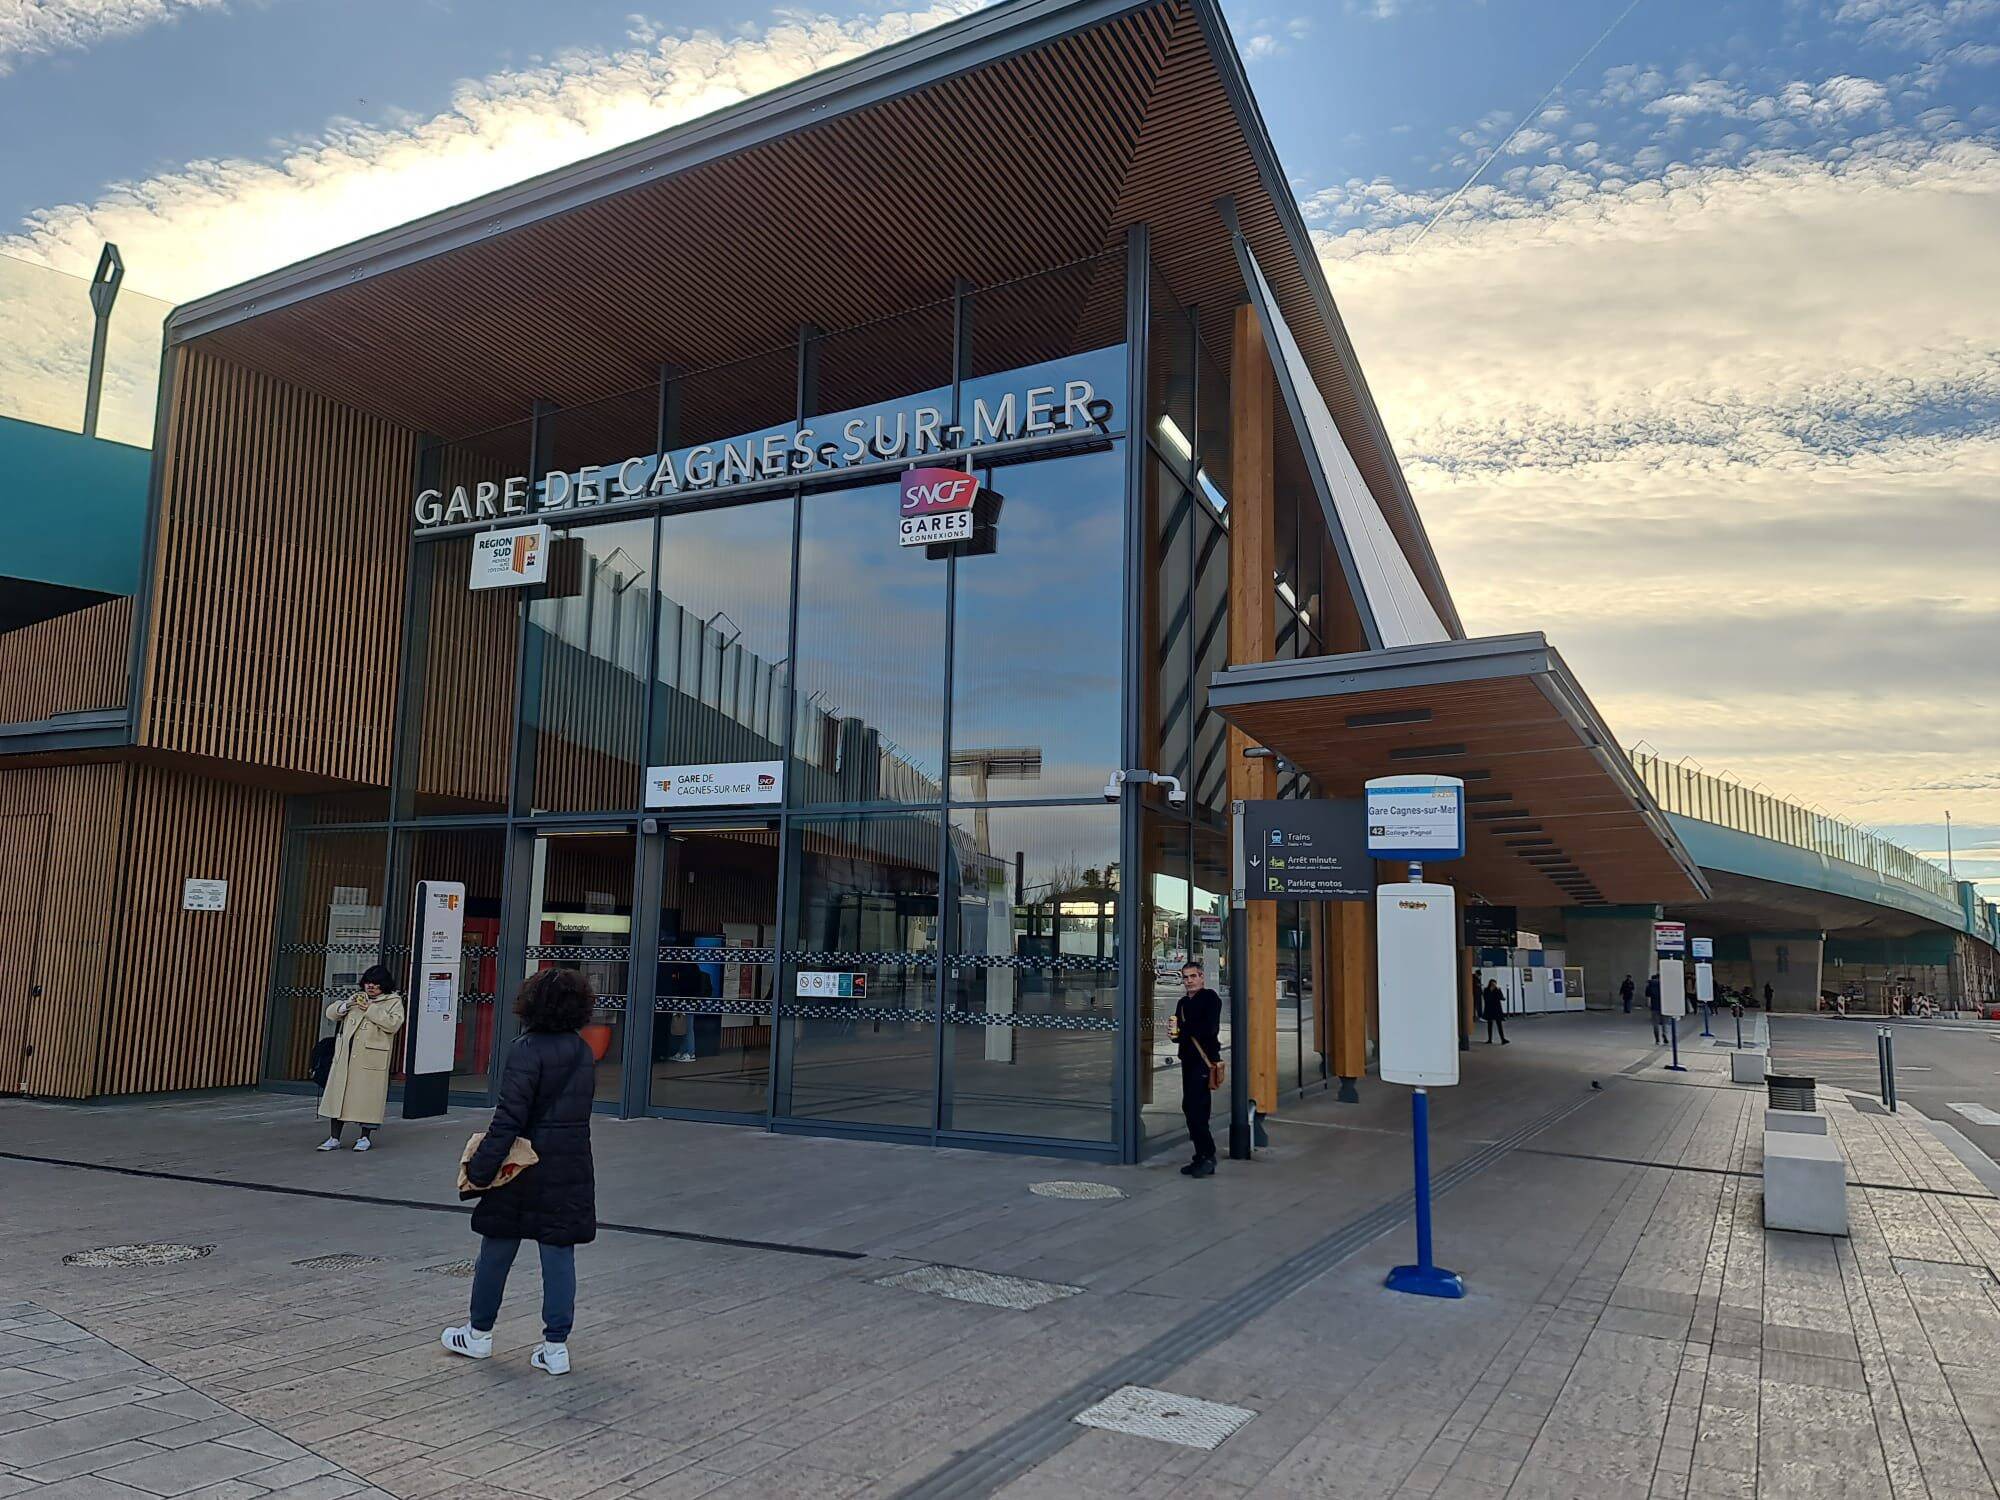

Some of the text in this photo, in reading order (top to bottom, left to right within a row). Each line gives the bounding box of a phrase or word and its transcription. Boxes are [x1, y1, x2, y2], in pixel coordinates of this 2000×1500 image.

[414, 380, 1095, 524] GARE DE CAGNES-SUR-MER
[903, 480, 970, 509] SNCF
[901, 514, 967, 534] GARES
[910, 530, 964, 542] CONNEXIONS
[493, 547, 511, 557] SUD
[677, 774, 714, 784] GARE DE
[677, 784, 751, 795] CAGNES-SUR-MER
[1369, 805, 1456, 817] Gare Cagnes-sur-Mer
[1287, 833, 1311, 841] Trains
[1287, 856, 1337, 864] Arrêt minute
[1287, 880, 1316, 888] Parking
